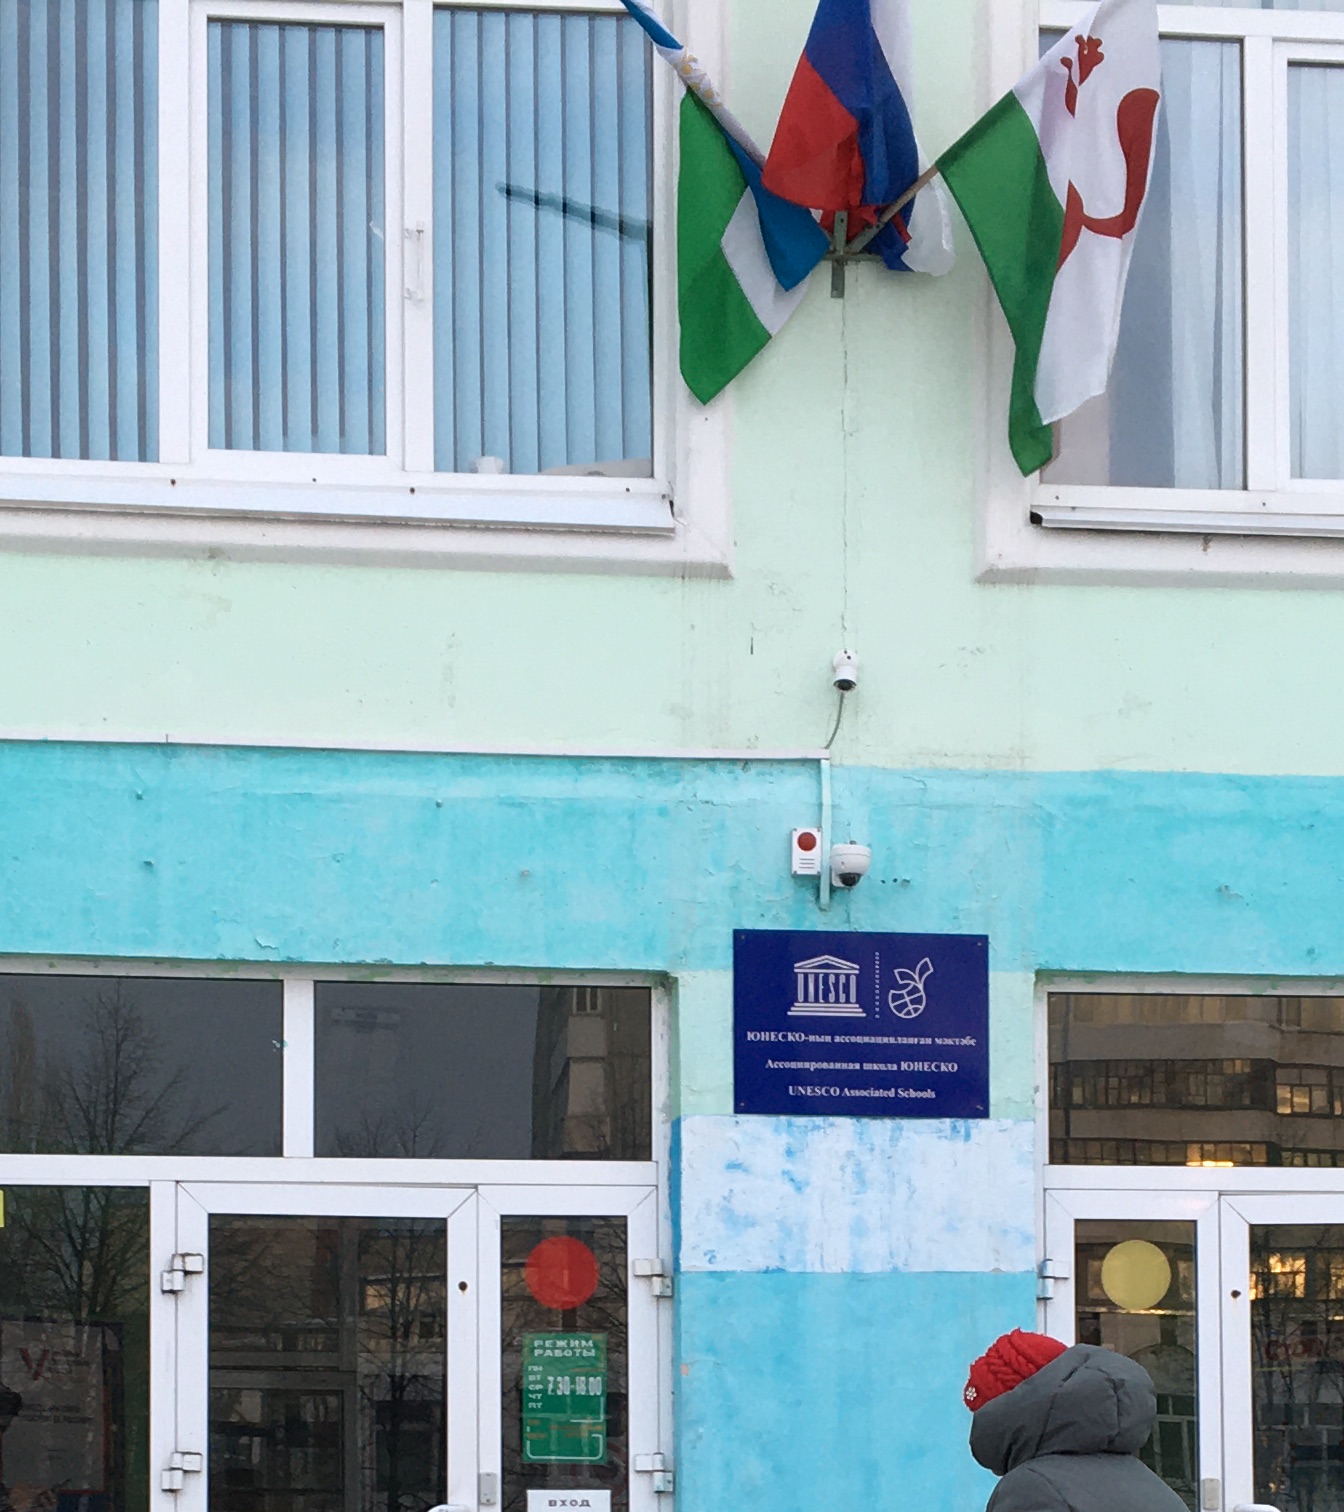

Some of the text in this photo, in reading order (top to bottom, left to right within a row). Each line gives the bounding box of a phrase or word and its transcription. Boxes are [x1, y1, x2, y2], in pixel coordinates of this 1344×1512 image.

[797, 973, 857, 1003] UNESCO
[863, 1062, 897, 1071] школа
[900, 1061, 958, 1073] ЮНЕСКО
[788, 1085, 936, 1099] UNESCO Associated Schools
[533, 1340, 594, 1348] РЕЖИМ
[533, 1349, 596, 1357] РАБОТЫ
[548, 1499, 592, 1508] ВХОД
